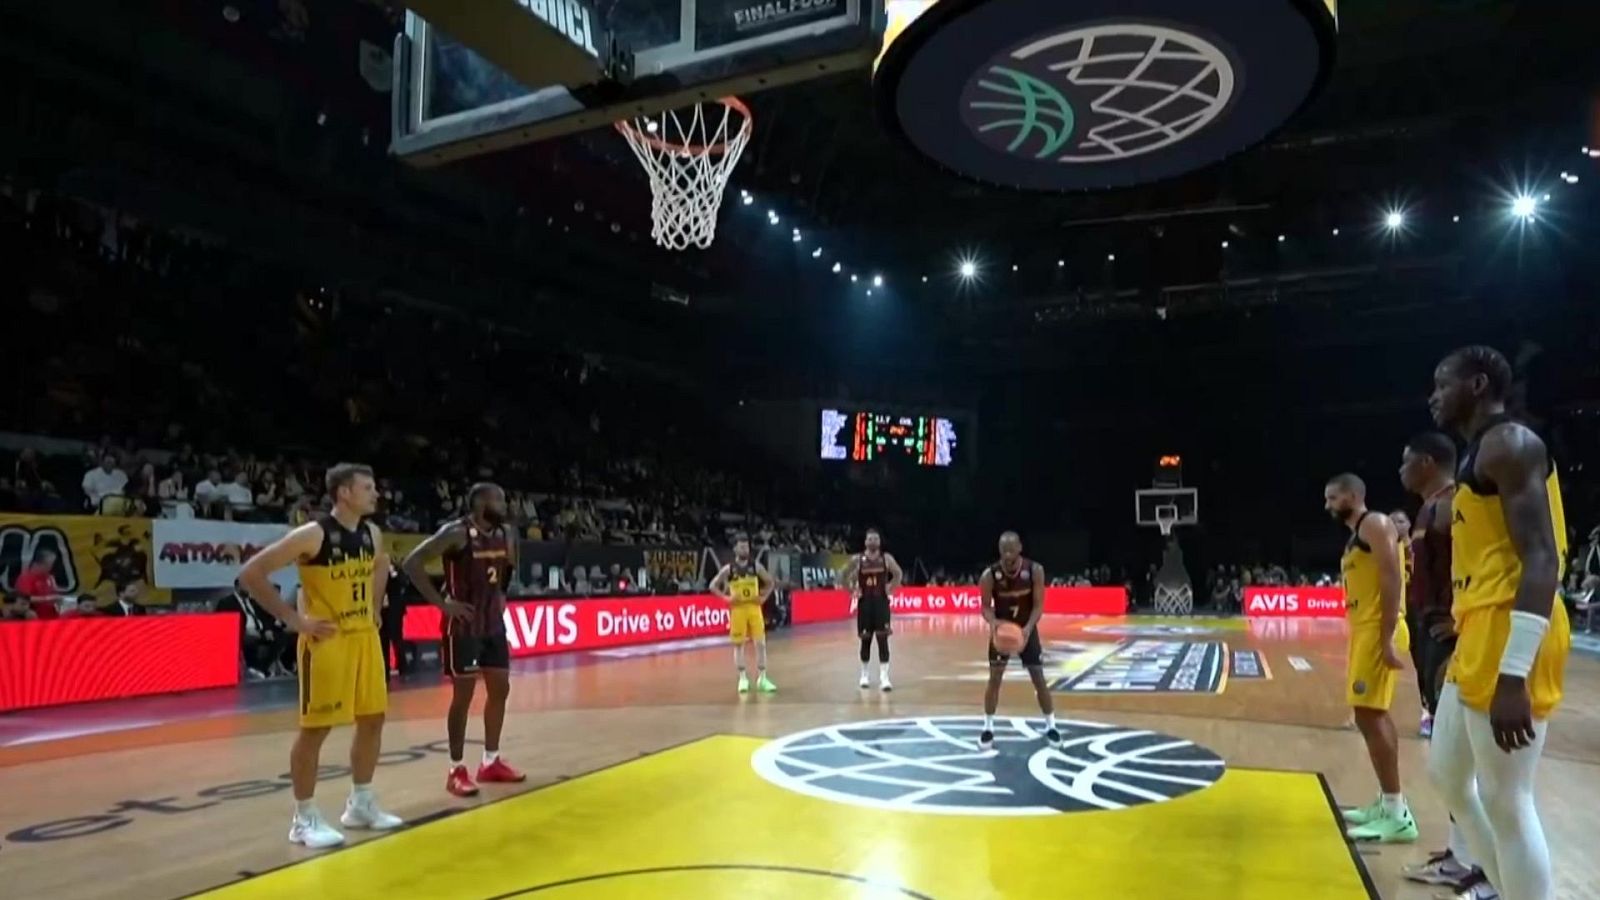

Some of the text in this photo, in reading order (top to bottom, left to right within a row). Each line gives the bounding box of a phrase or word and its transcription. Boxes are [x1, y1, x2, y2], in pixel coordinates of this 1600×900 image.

[734, 1, 787, 25] FINAL
[487, 566, 498, 584] 2
[802, 566, 838, 590] FINA
[928, 593, 946, 608] to
[1249, 593, 1299, 612] AVIS
[1307, 598, 1339, 609] Drive
[597, 608, 650, 636] Drive
[655, 609, 675, 631] to
[680, 604, 731, 630] Victory
[1008, 605, 1020, 619] 7
